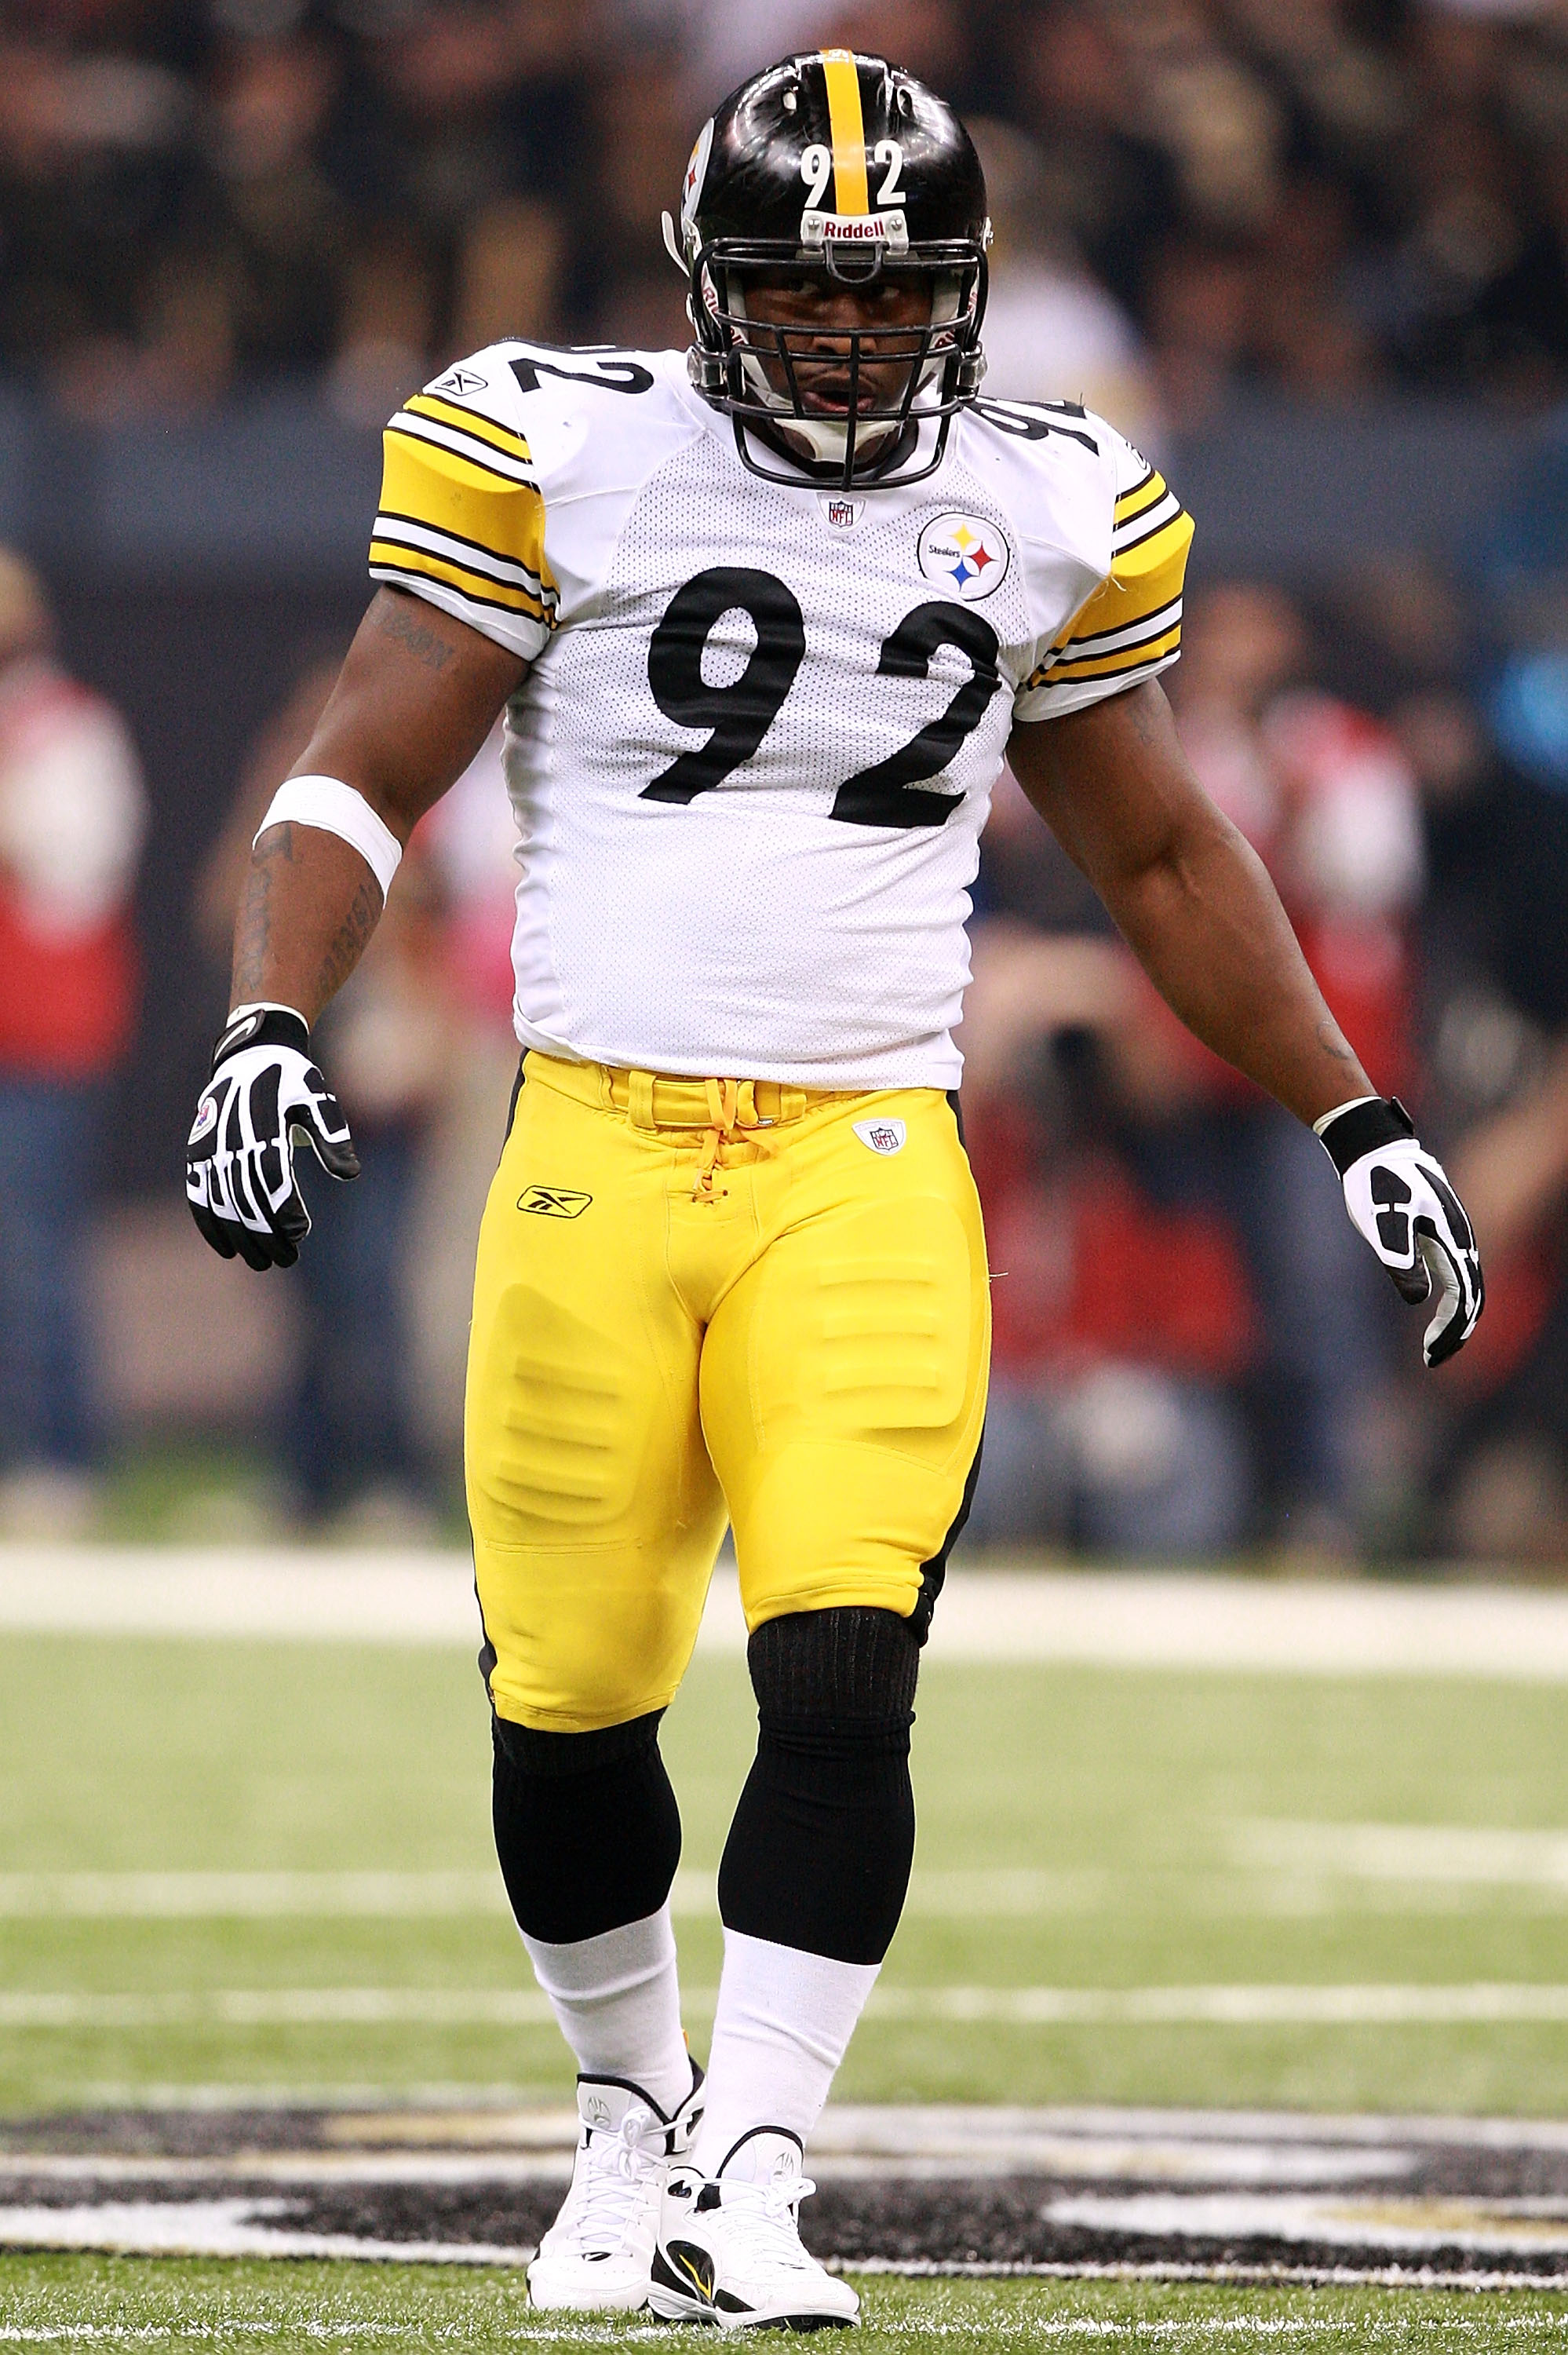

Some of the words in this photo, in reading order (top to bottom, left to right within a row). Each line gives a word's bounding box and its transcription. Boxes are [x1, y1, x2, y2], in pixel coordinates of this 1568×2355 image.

[800, 140, 906, 208] 92
[824, 218, 884, 239] Riddell
[928, 544, 961, 558] Steelers
[638, 566, 1002, 828] 92
